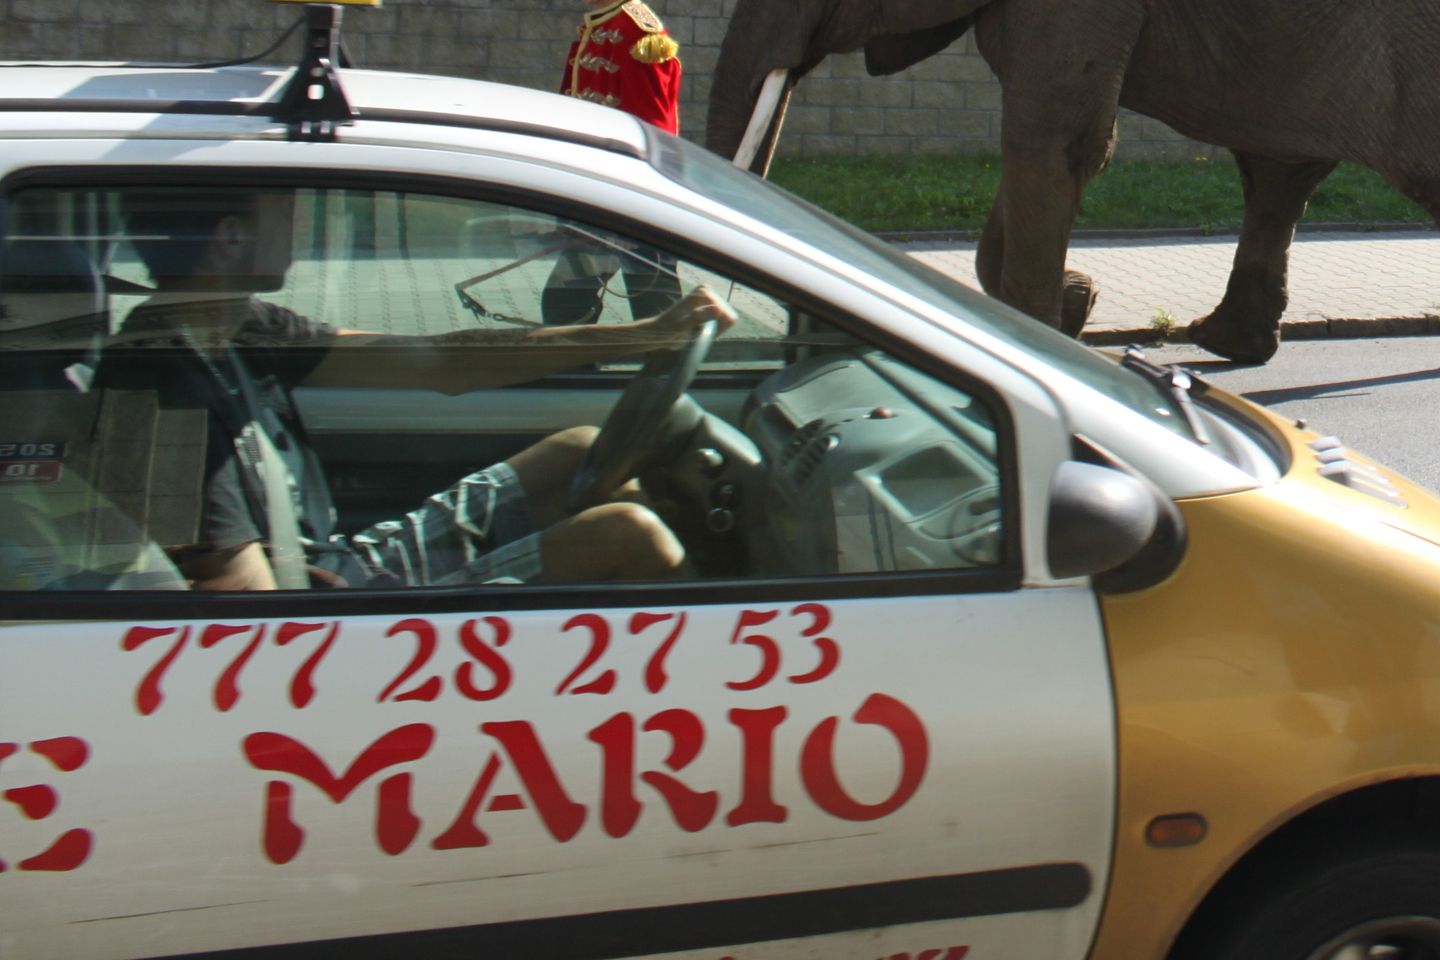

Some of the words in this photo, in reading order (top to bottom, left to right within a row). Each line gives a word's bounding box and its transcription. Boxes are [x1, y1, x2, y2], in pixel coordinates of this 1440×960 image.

[120, 621, 342, 716] 777
[378, 615, 514, 703] 28
[555, 610, 688, 696] 27
[725, 602, 842, 692] 53
[241, 692, 931, 866] MARIO
